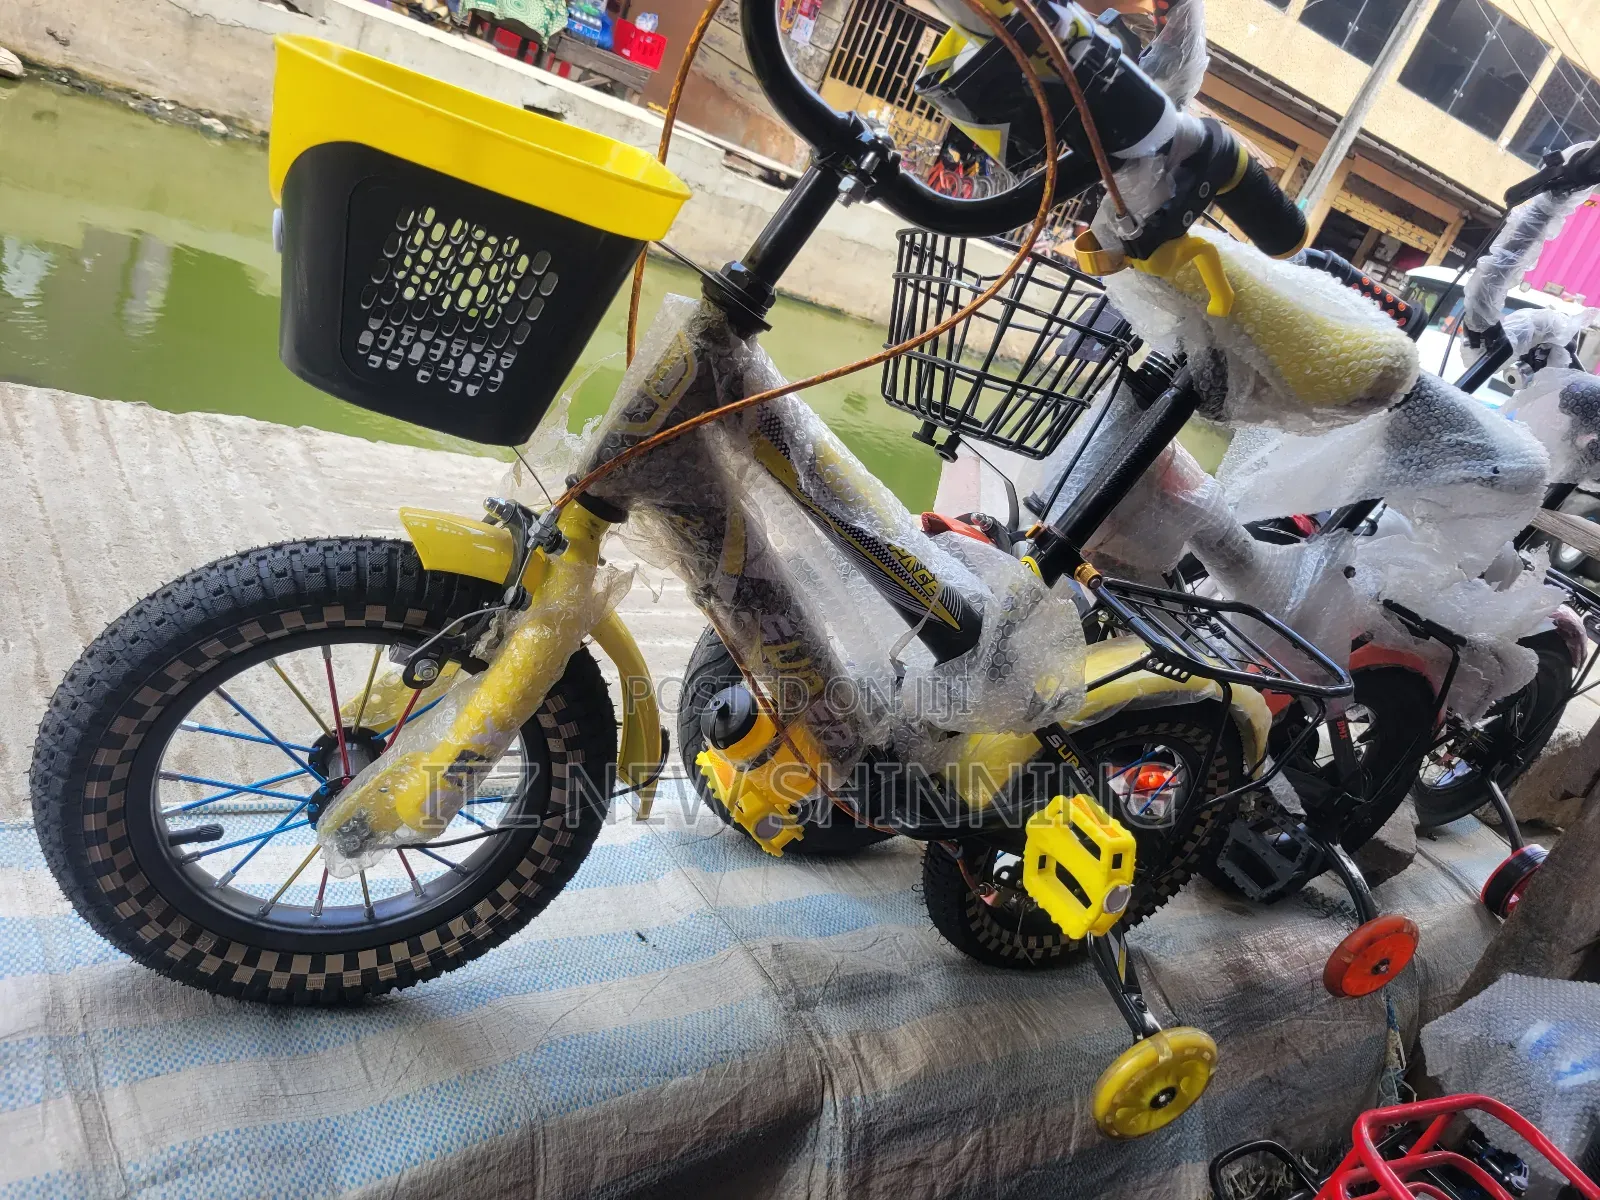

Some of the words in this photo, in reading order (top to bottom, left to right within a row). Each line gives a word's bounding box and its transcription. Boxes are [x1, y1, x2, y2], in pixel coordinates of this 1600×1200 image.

[1448, 245, 1466, 258] CASIO
[1336, 721, 1348, 739] BMX
[1045, 734, 1095, 789] SUPER
